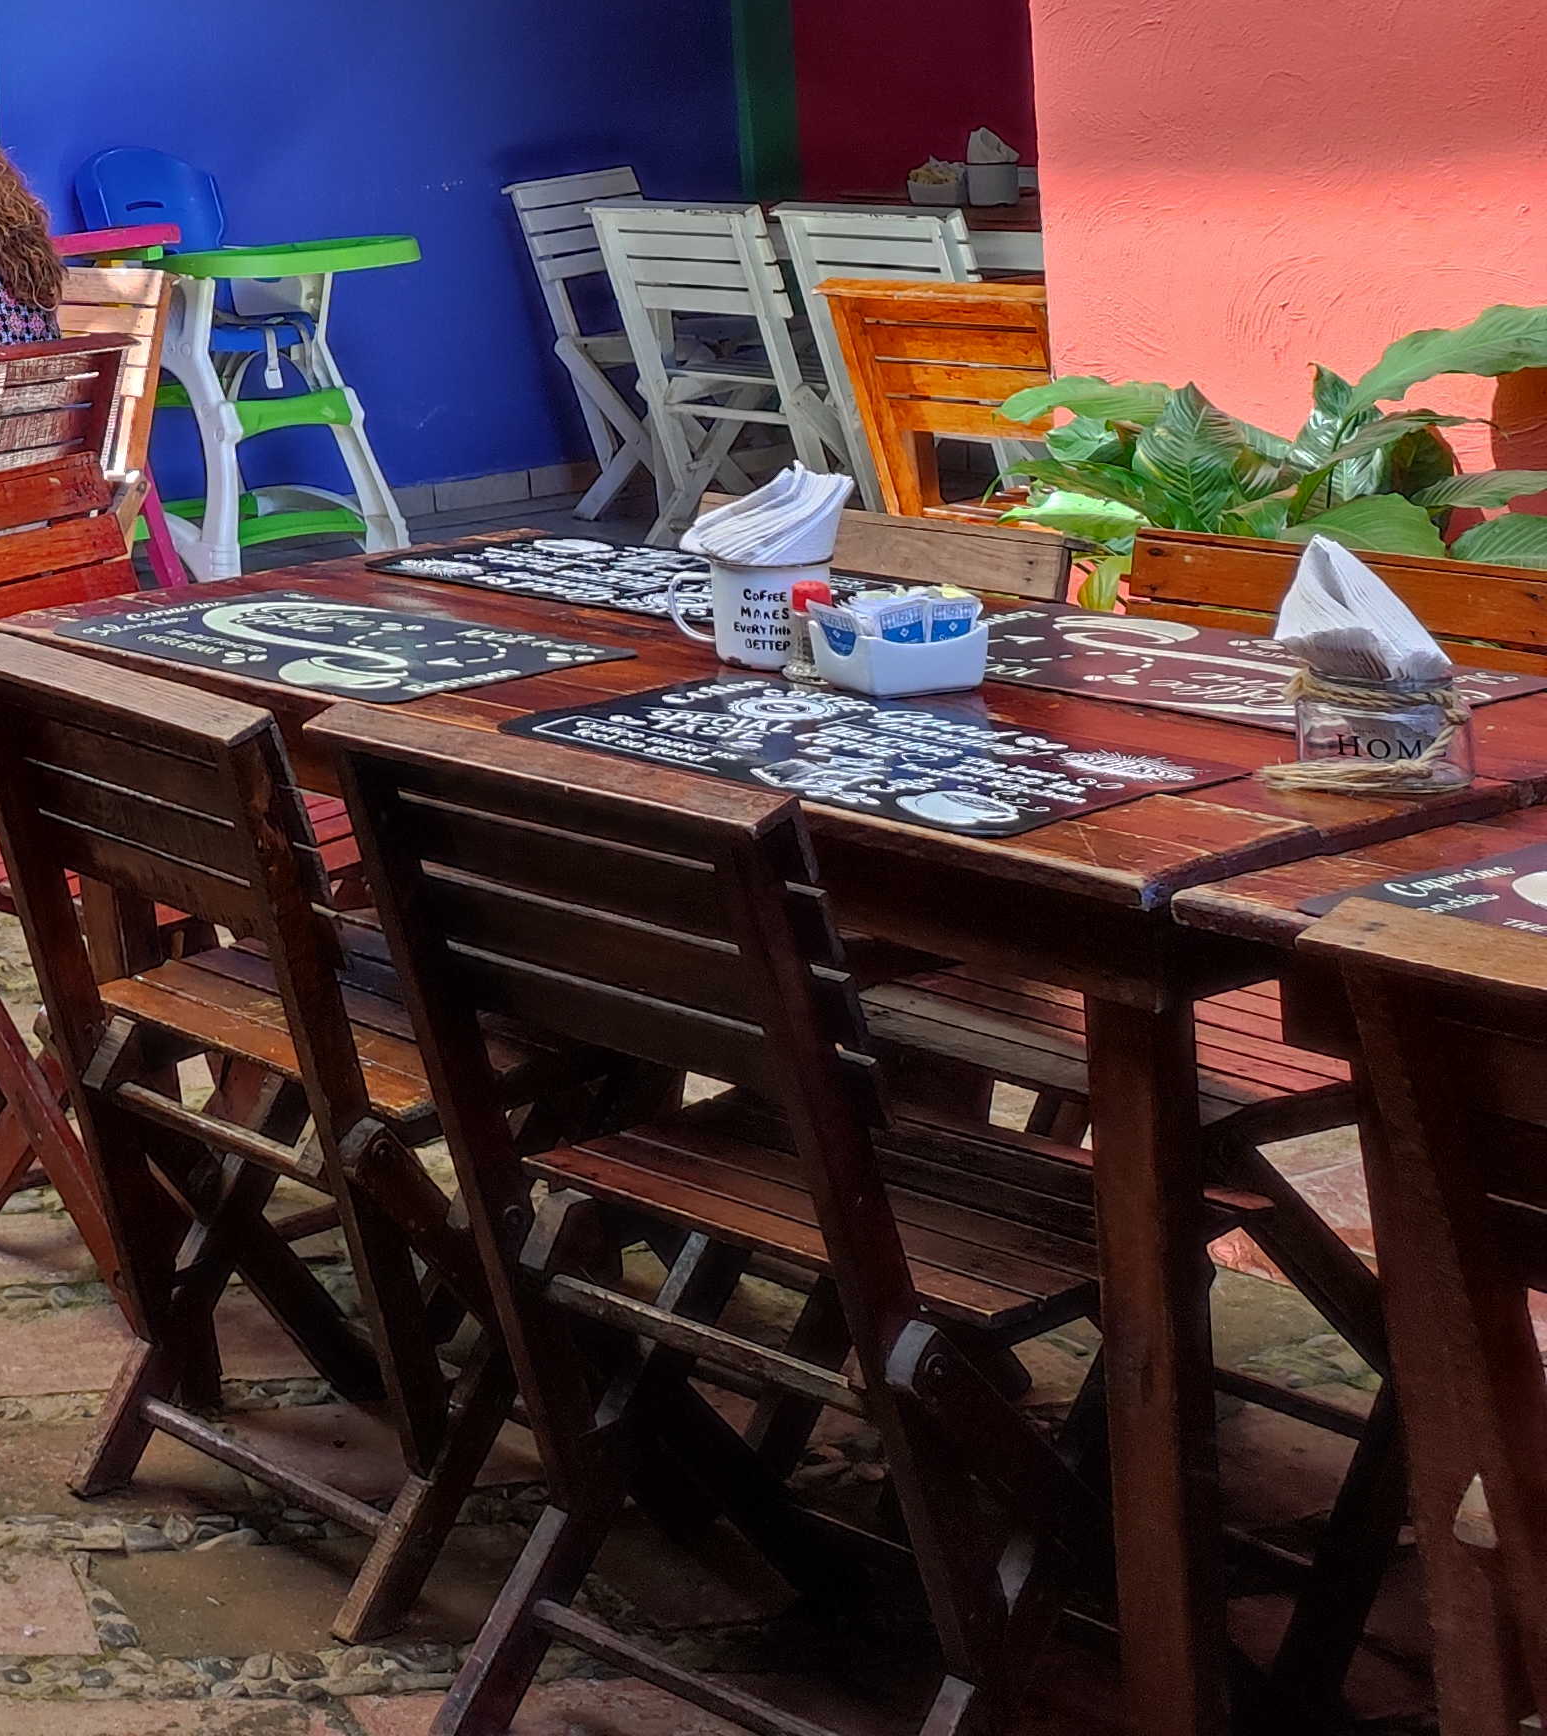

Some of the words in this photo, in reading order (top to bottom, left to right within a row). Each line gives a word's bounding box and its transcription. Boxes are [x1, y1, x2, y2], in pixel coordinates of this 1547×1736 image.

[646, 710, 793, 734] SPECIAL
[652, 721, 772, 741] TASTE
[793, 732, 905, 757] COFFEE
[817, 725, 964, 757] DELICIOUS
[644, 745, 713, 763] good
